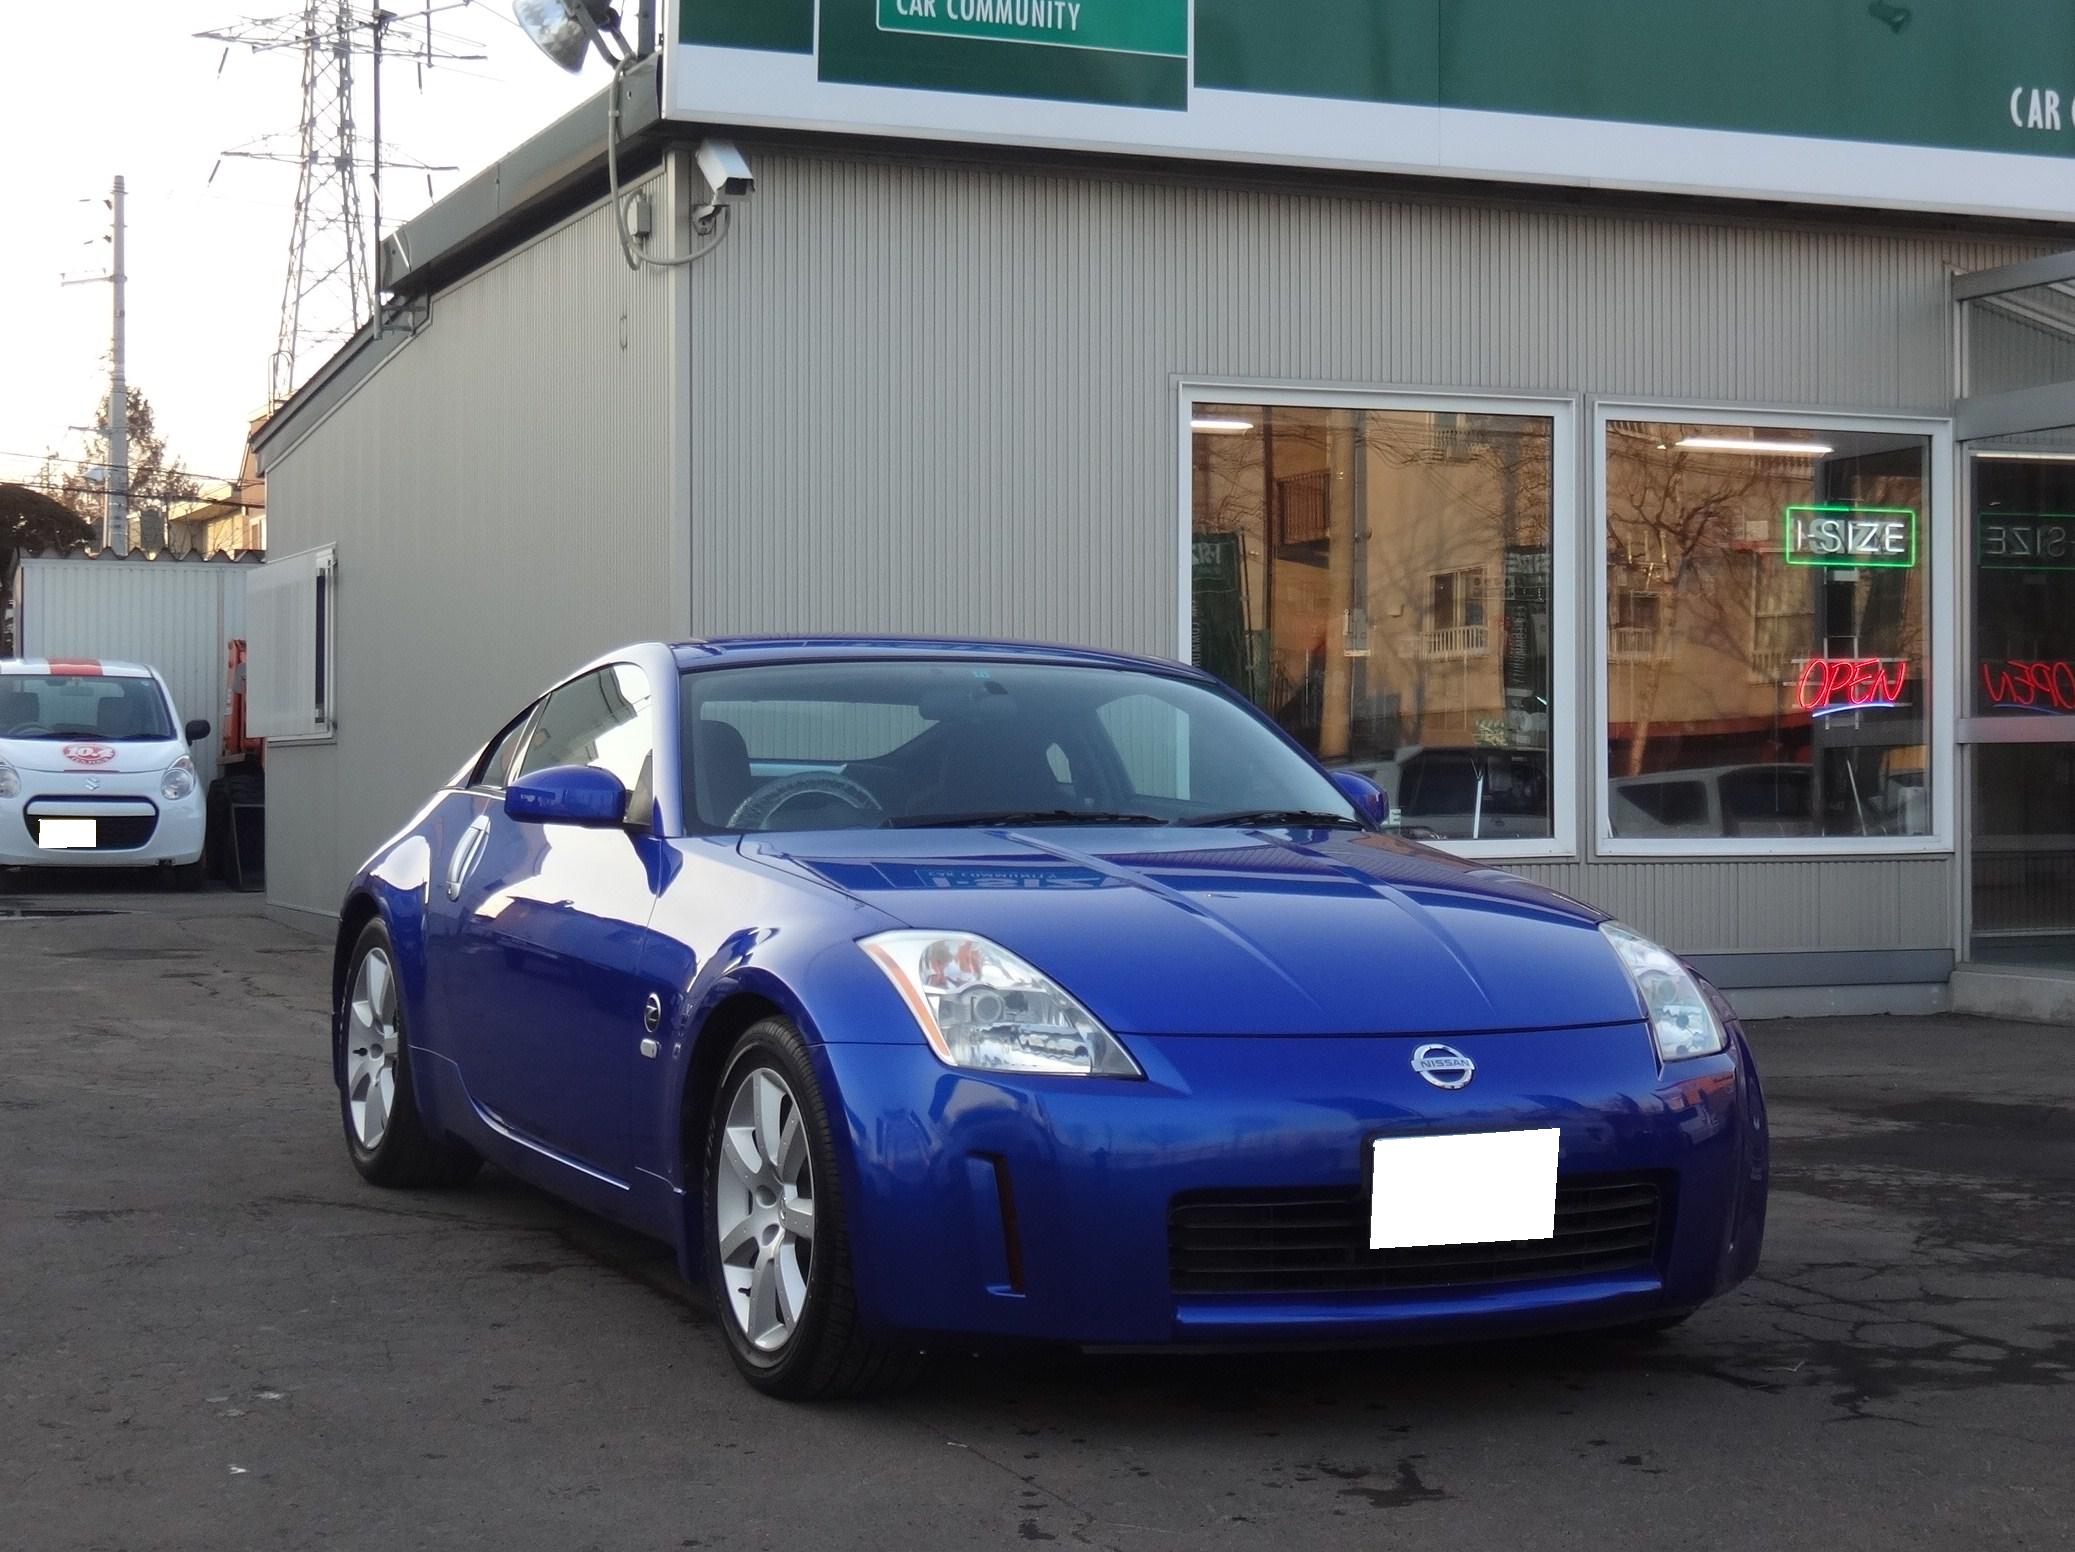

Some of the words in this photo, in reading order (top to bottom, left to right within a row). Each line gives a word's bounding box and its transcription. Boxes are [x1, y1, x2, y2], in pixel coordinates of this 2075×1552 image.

[896, 0, 936, 17] CAR
[947, 0, 1080, 31] COMMUNITY
[2009, 86, 2061, 130] CAR
[1797, 519, 1905, 553] I-SIZE
[1799, 658, 1906, 708] OPEN
[1421, 1060, 1469, 1068] NISSAN
